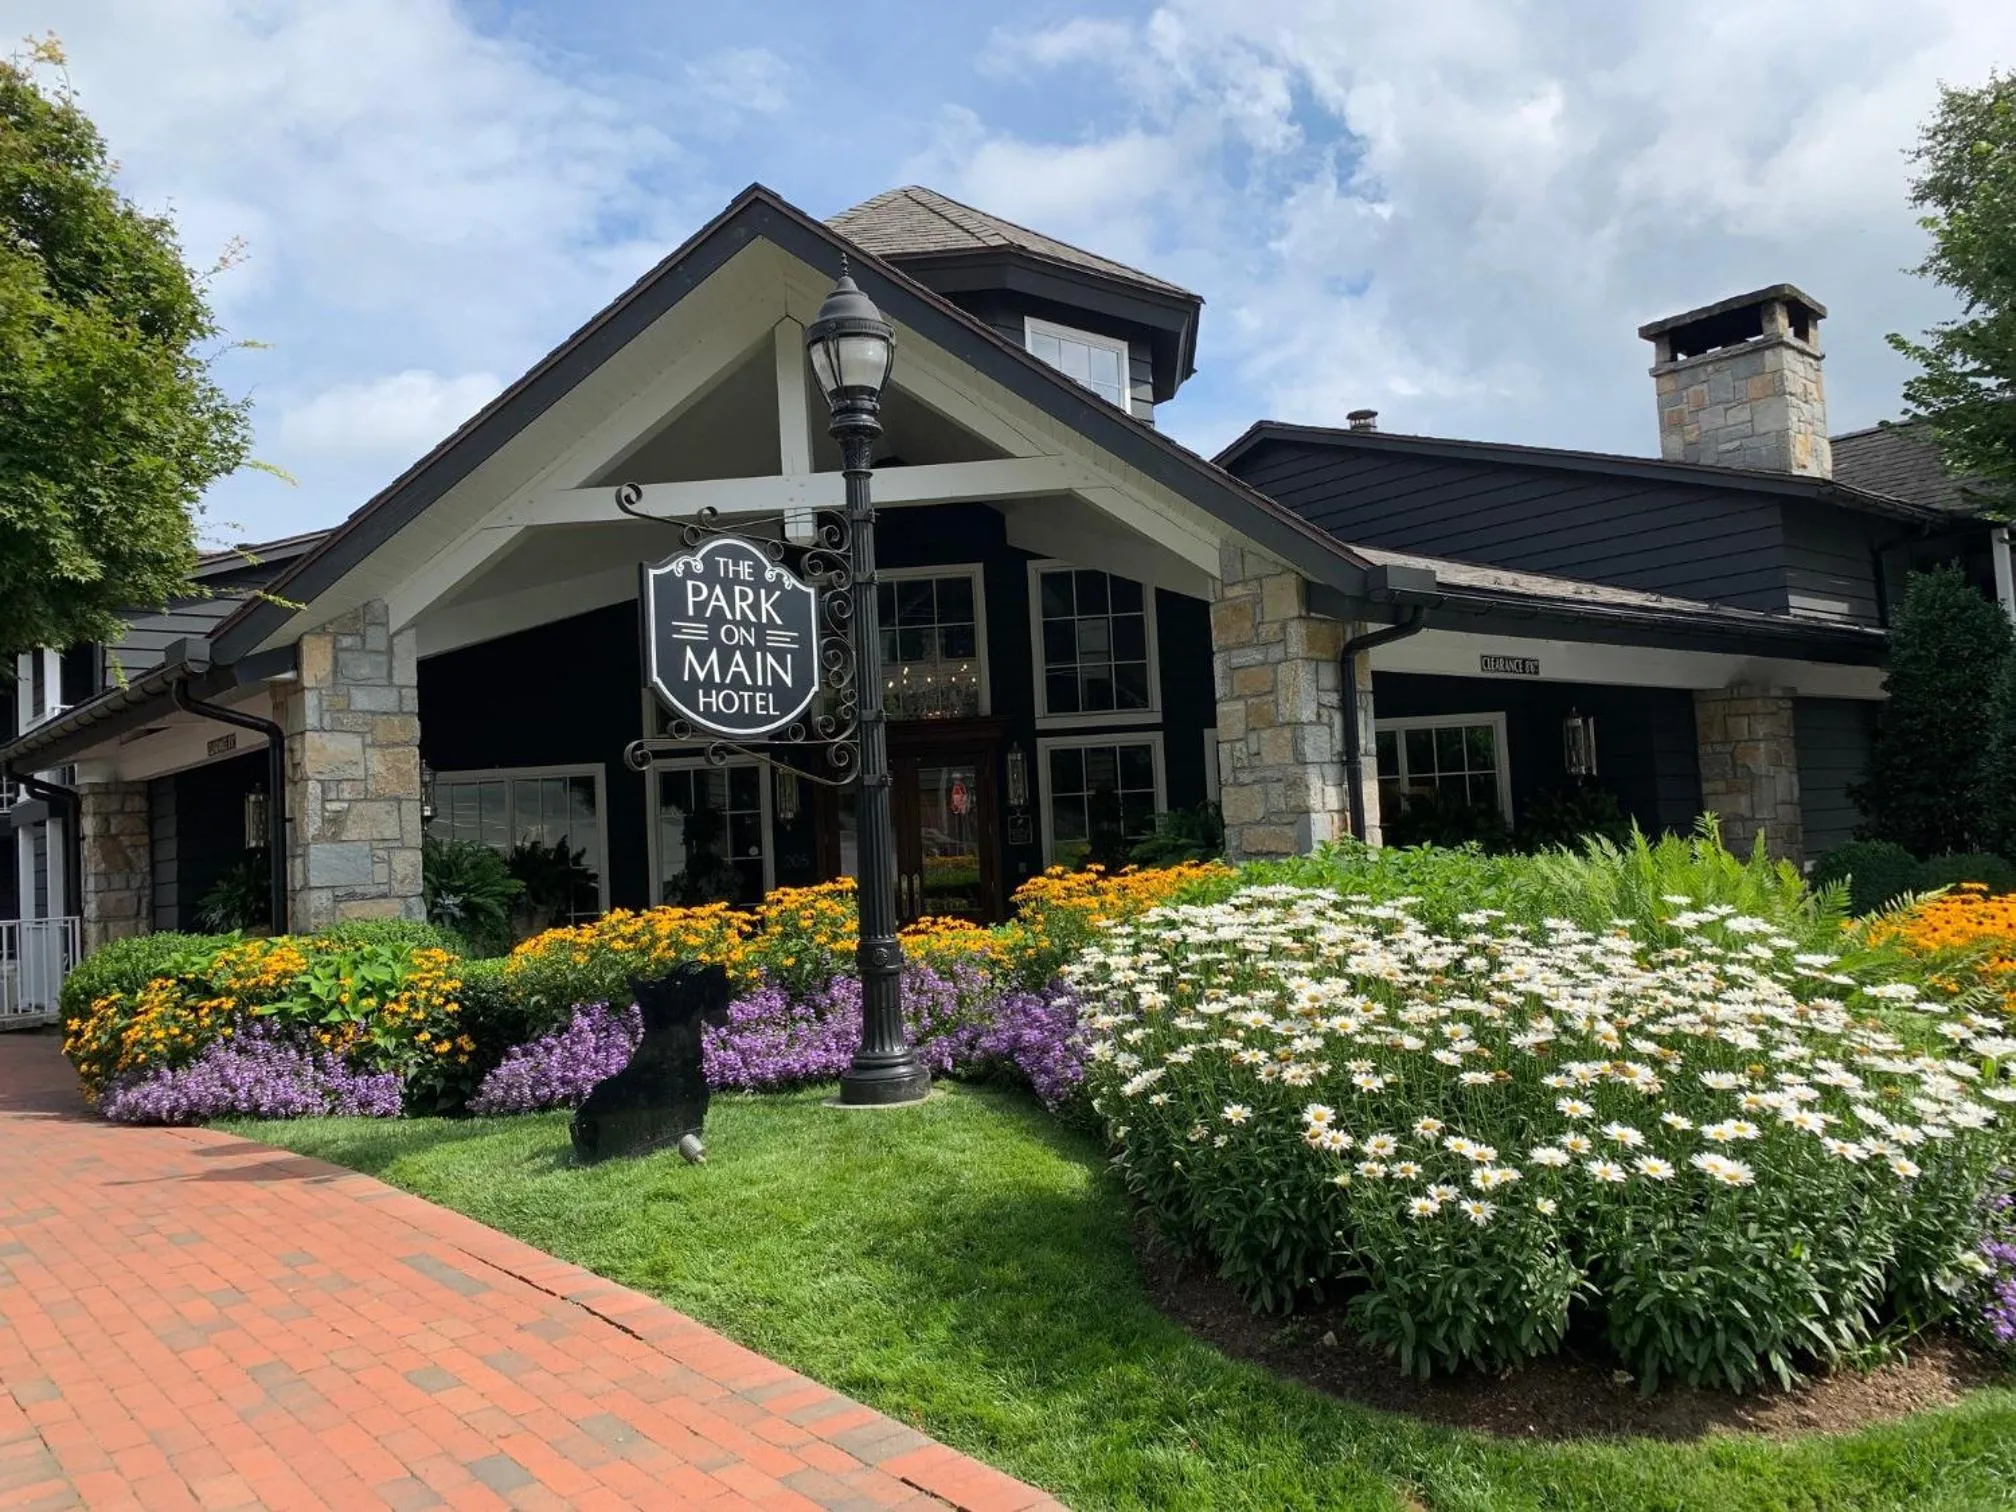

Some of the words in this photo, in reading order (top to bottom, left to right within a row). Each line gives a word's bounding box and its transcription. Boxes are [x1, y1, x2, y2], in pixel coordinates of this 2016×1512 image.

[714, 557, 755, 581] THE
[686, 579, 784, 625] PARK
[720, 624, 755, 647] ON
[683, 645, 793, 688] MAIN
[698, 688, 780, 715] HOTEL
